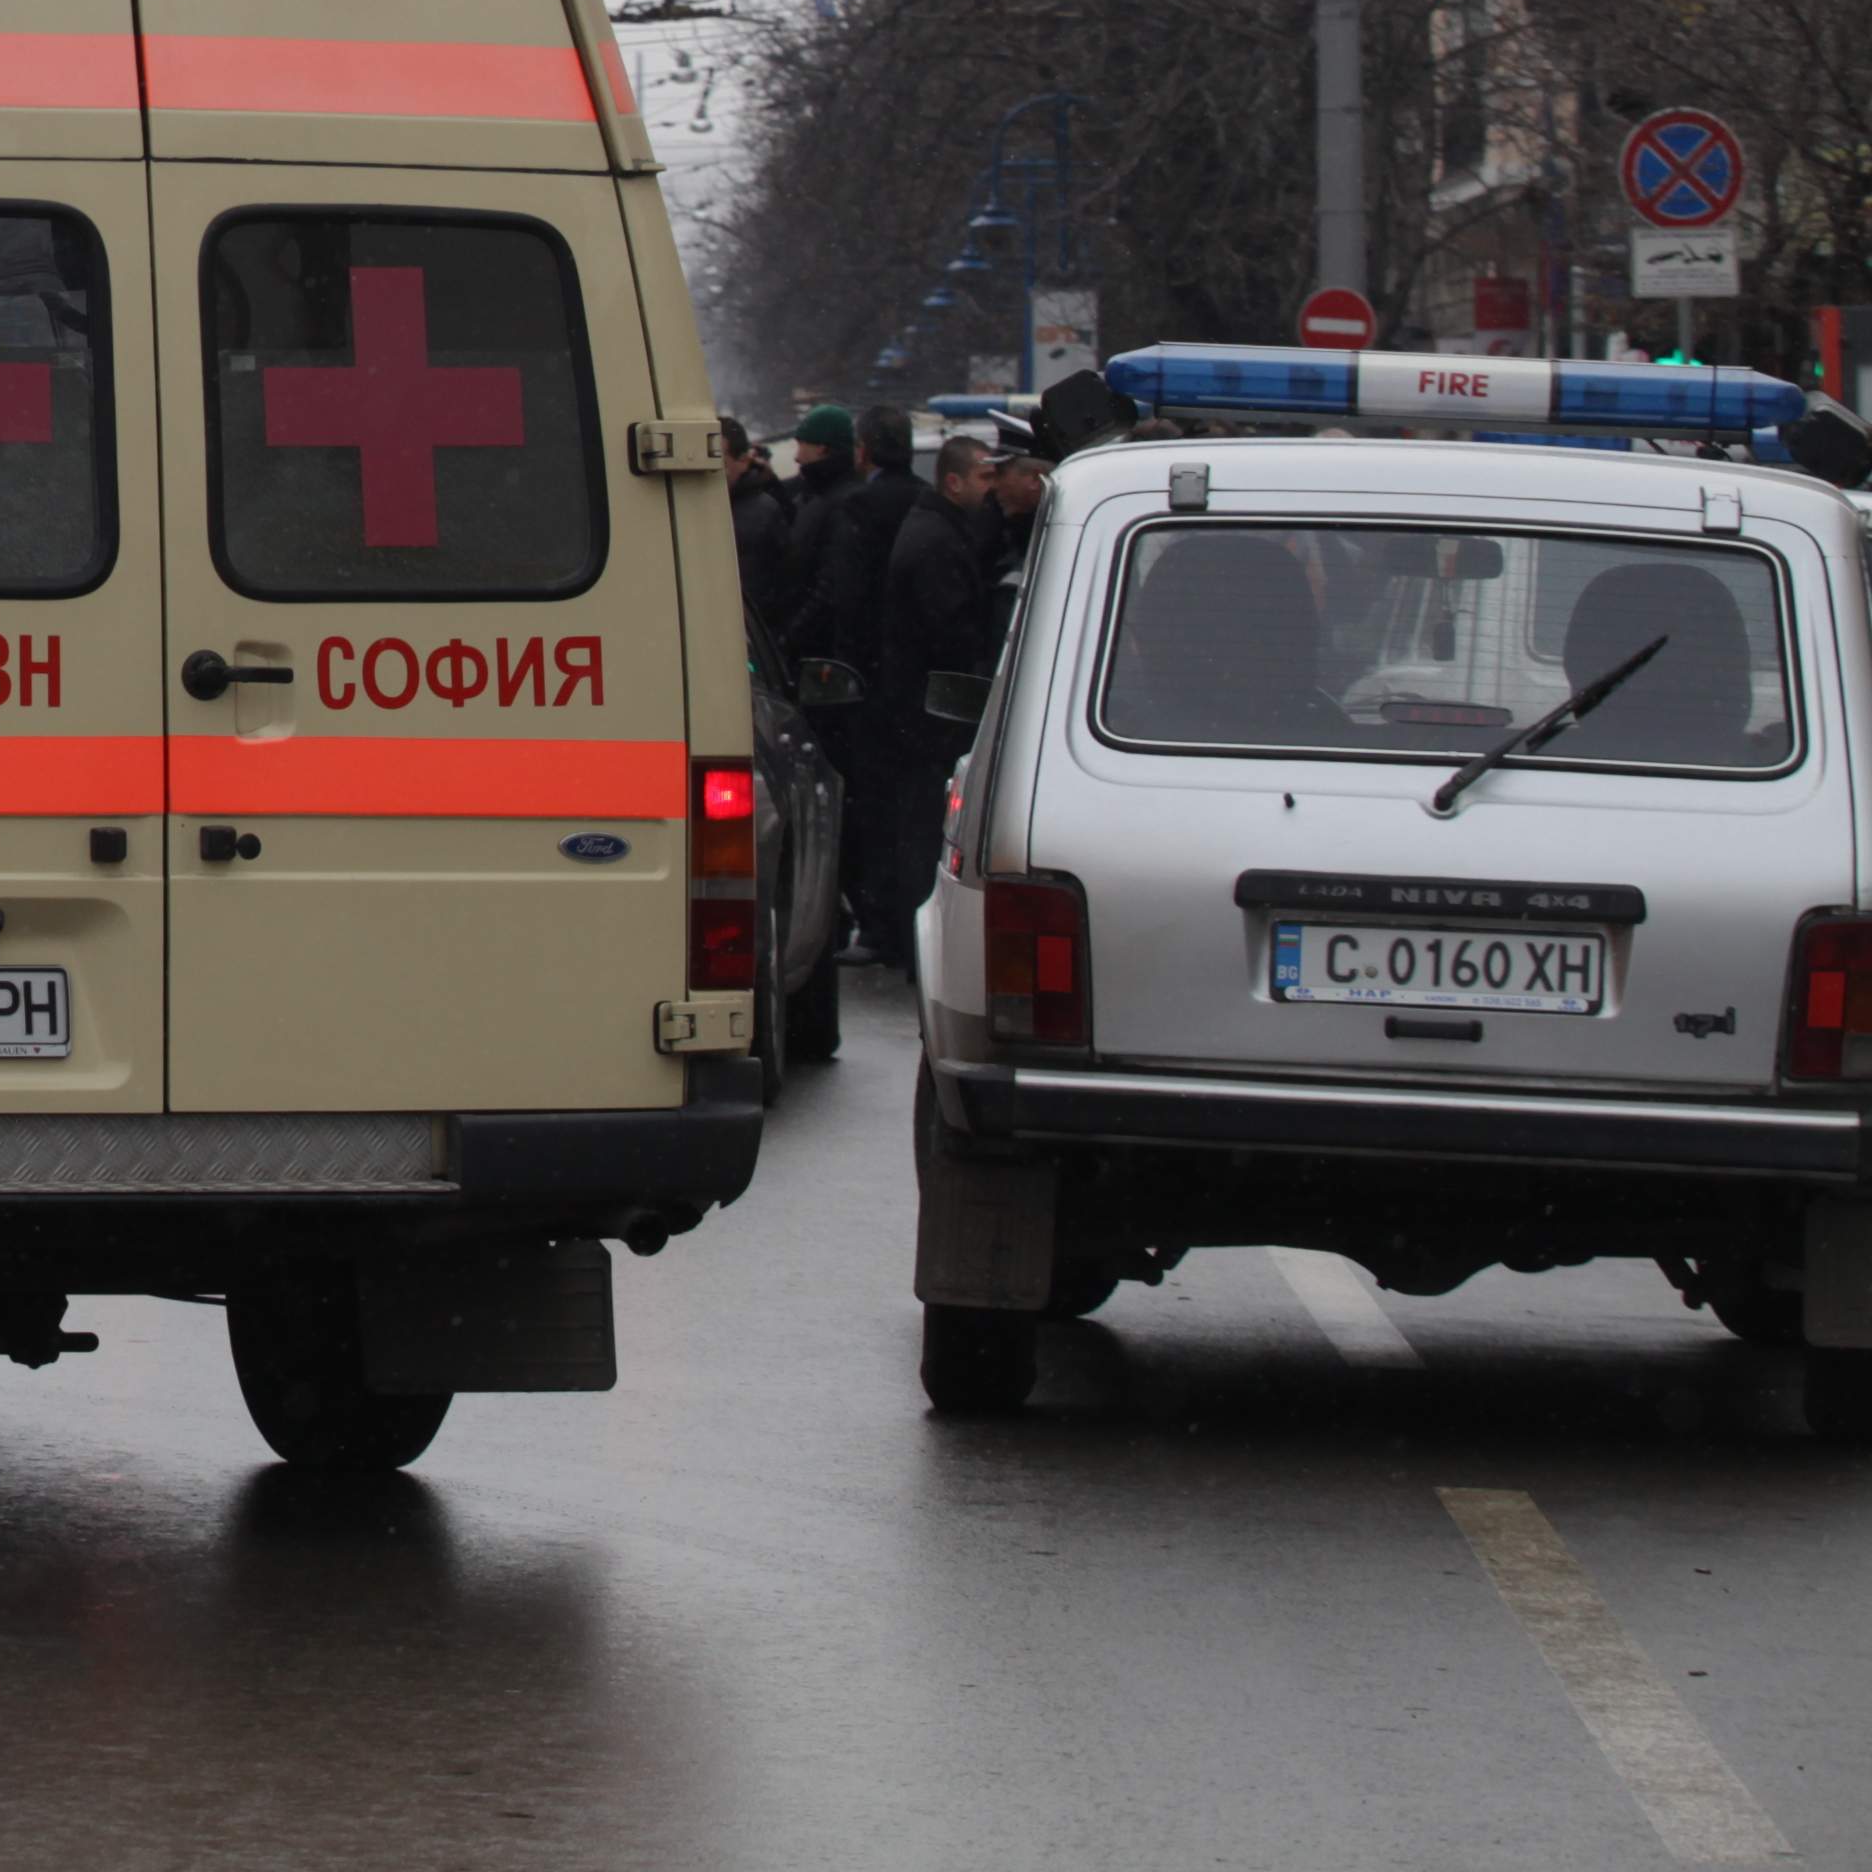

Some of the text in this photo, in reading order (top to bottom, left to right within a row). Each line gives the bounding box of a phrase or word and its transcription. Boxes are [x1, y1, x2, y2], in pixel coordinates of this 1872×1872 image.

[1418, 370, 1490, 398] FIRE
[316, 634, 604, 711] СОФИЯ
[576, 837, 615, 855] Ford
[1298, 886, 1363, 898] LADA
[1390, 887, 1503, 907] NIVA
[1276, 964, 1299, 981] BG
